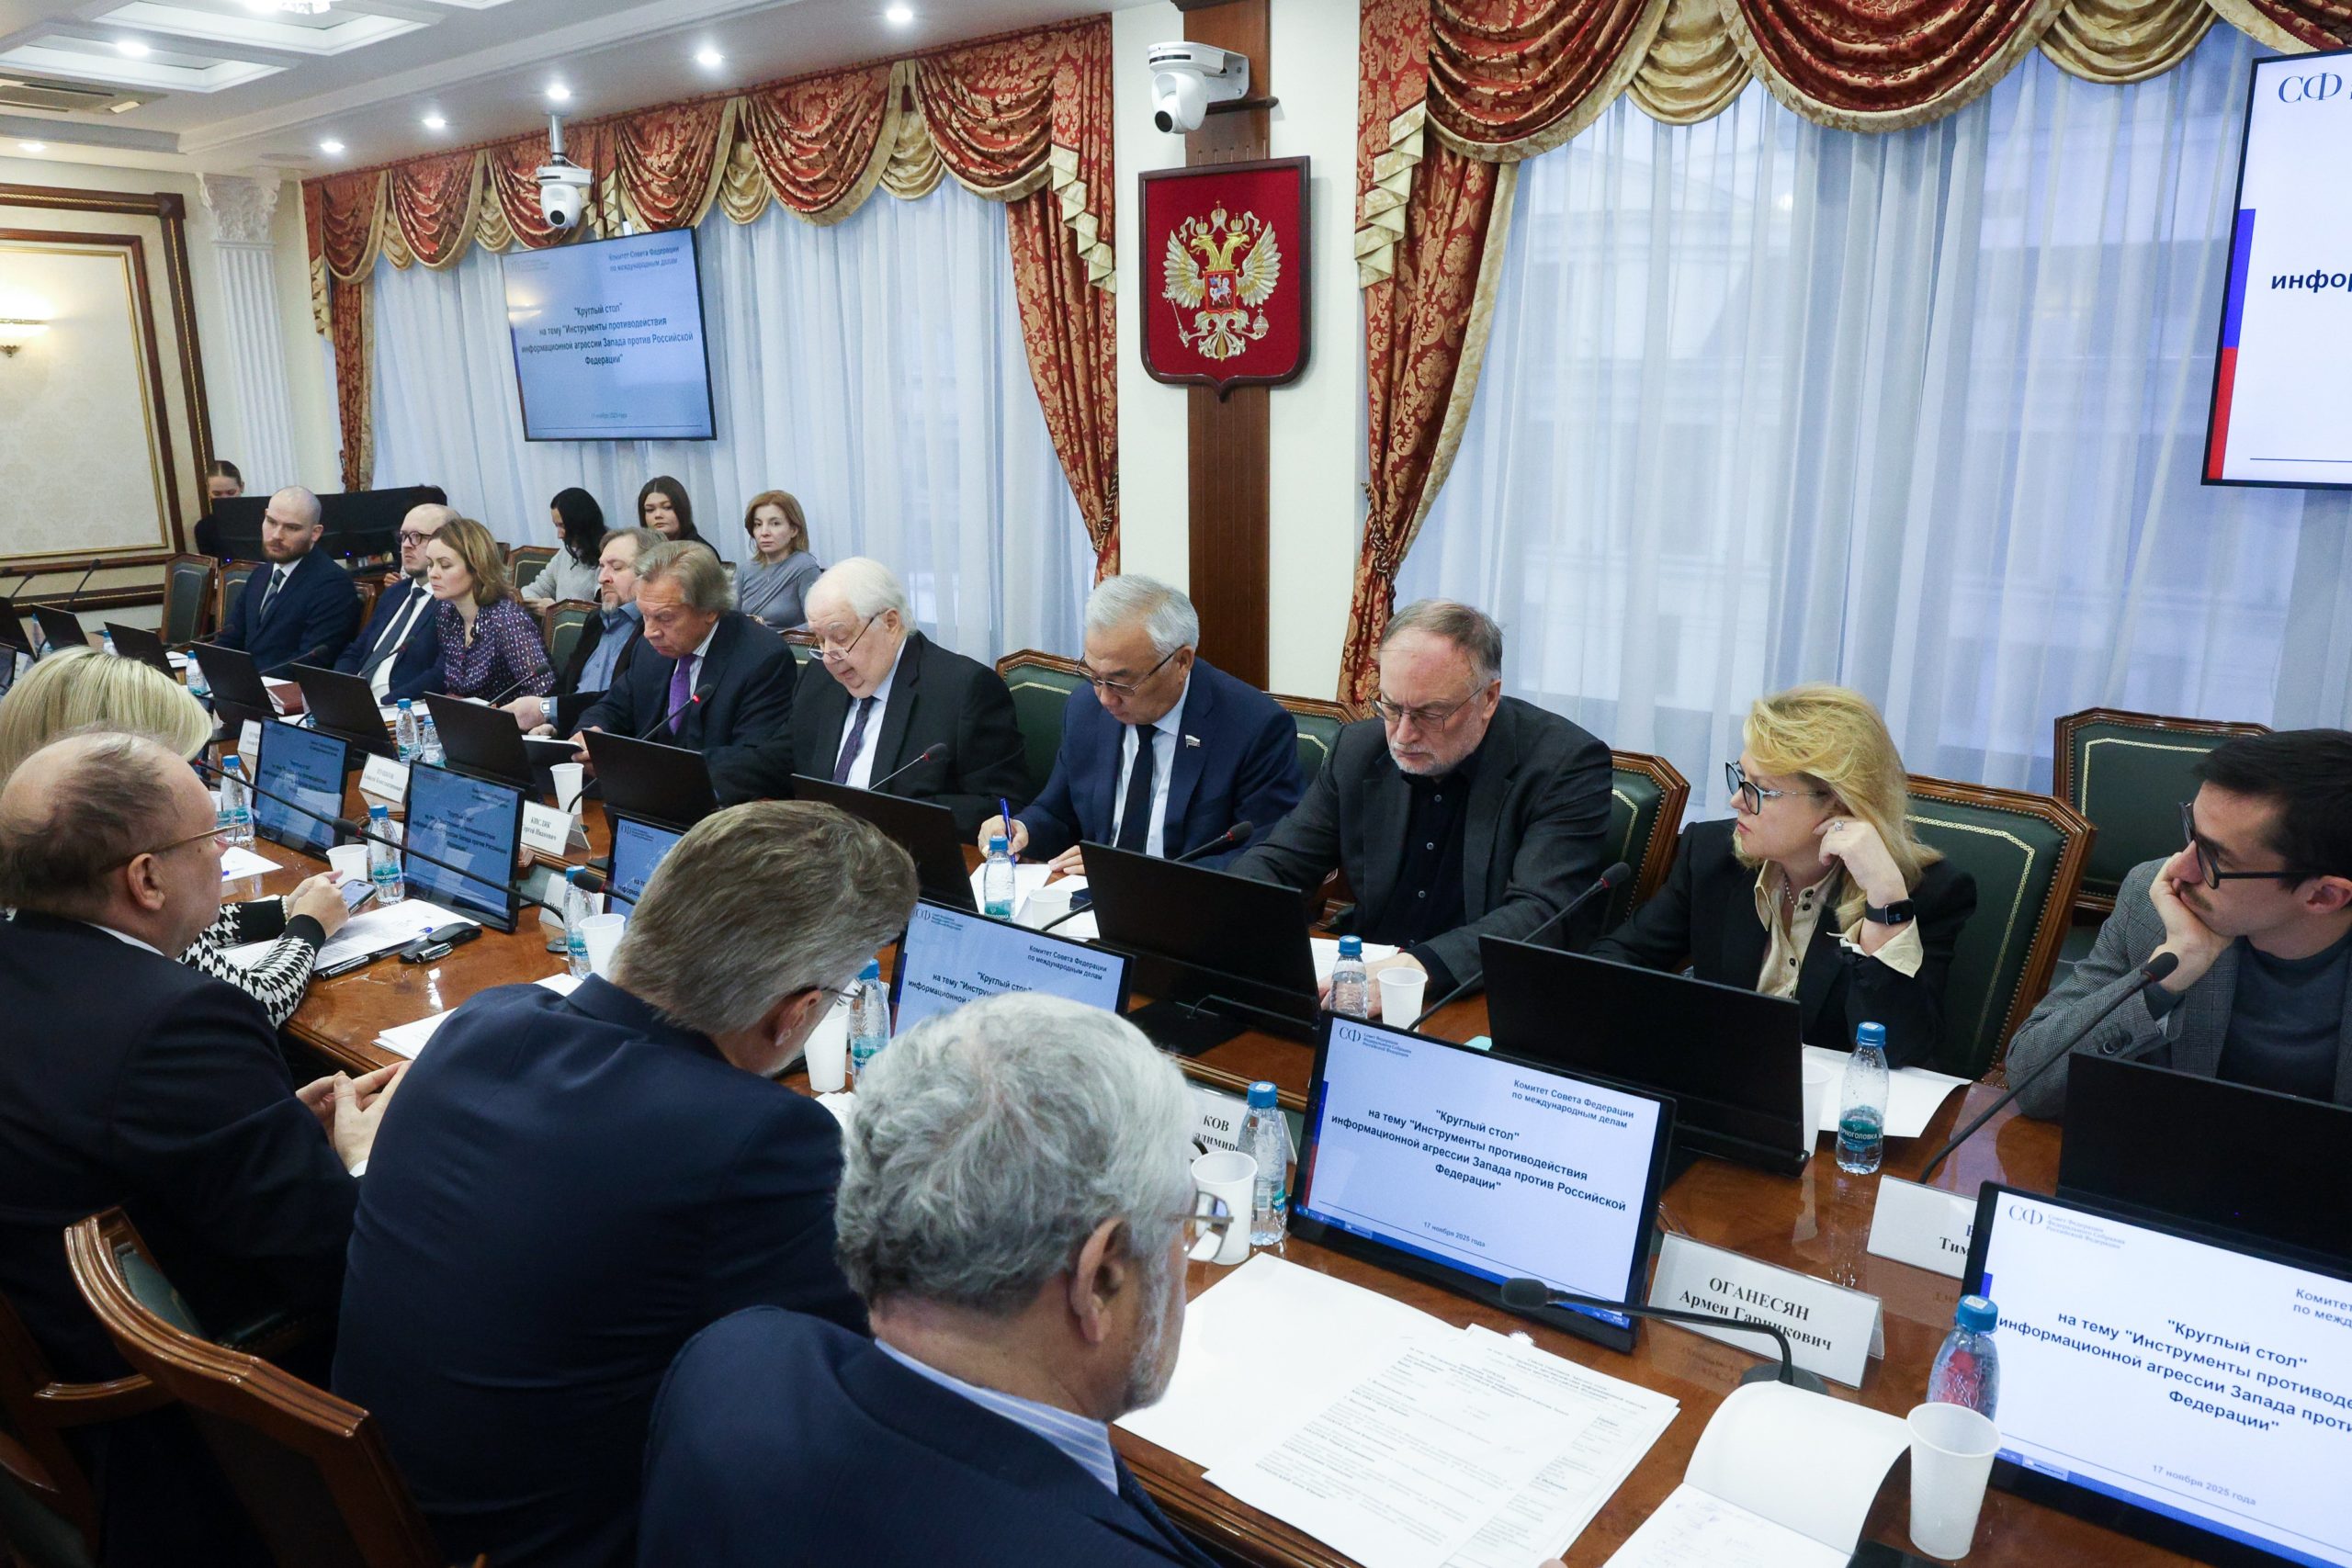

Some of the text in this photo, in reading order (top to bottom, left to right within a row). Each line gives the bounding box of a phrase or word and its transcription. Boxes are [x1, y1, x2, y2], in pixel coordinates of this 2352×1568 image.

[2278, 73, 2342, 103] СФ
[2271, 269, 2352, 293] инфо
[548, 325, 561, 338] тему
[561, 320, 607, 335] "Инструменты
[608, 316, 667, 331] противодействия
[521, 332, 694, 355] информационной агрессии Запада против Российской
[584, 353, 623, 367] Федерации"
[1029, 944, 1107, 972] Комитет Совета Федерации
[1035, 957, 1083, 975] международным
[1083, 970, 1102, 980] делам
[908, 979, 967, 1004] информационной
[933, 974, 942, 982] на
[942, 976, 959, 989] тему
[977, 971, 1011, 988] "Круглый
[1340, 1026, 1361, 1042] СФ
[1512, 1091, 1628, 1129] по международным делам
[1514, 1079, 1634, 1119] Комитет Совета Федерации
[1436, 1109, 1520, 1141] "Круглый стол"
[1368, 1109, 1589, 1181] на тему "Инструменты противодействия
[1331, 1115, 1626, 1212] информационной агрессии Запада против Российской
[1435, 1163, 1501, 1190] Федерации"
[2009, 1204, 2042, 1224] СФ
[1431, 1225, 1454, 1236] ноября
[1455, 1232, 1470, 1242] 2025
[1471, 1238, 1486, 1247] года
[1679, 1290, 1729, 1317] Армен
[1709, 1278, 1810, 1321] ОГАНЕСЯН
[2293, 1304, 2311, 1314] по
[2057, 1313, 2076, 1326] на
[2081, 1319, 2120, 1341] тему
[2125, 1330, 2251, 1378] "Инструменты
[2167, 1319, 2308, 1369] "Круглый стол"
[1998, 1317, 2143, 1369] информационной
[2146, 1361, 2225, 1393] агрессии
[2230, 1385, 2296, 1416] Запада
[2169, 1390, 2279, 1431] Федерации"
[2153, 1464, 2256, 1506] 17 ноября 2025 года
